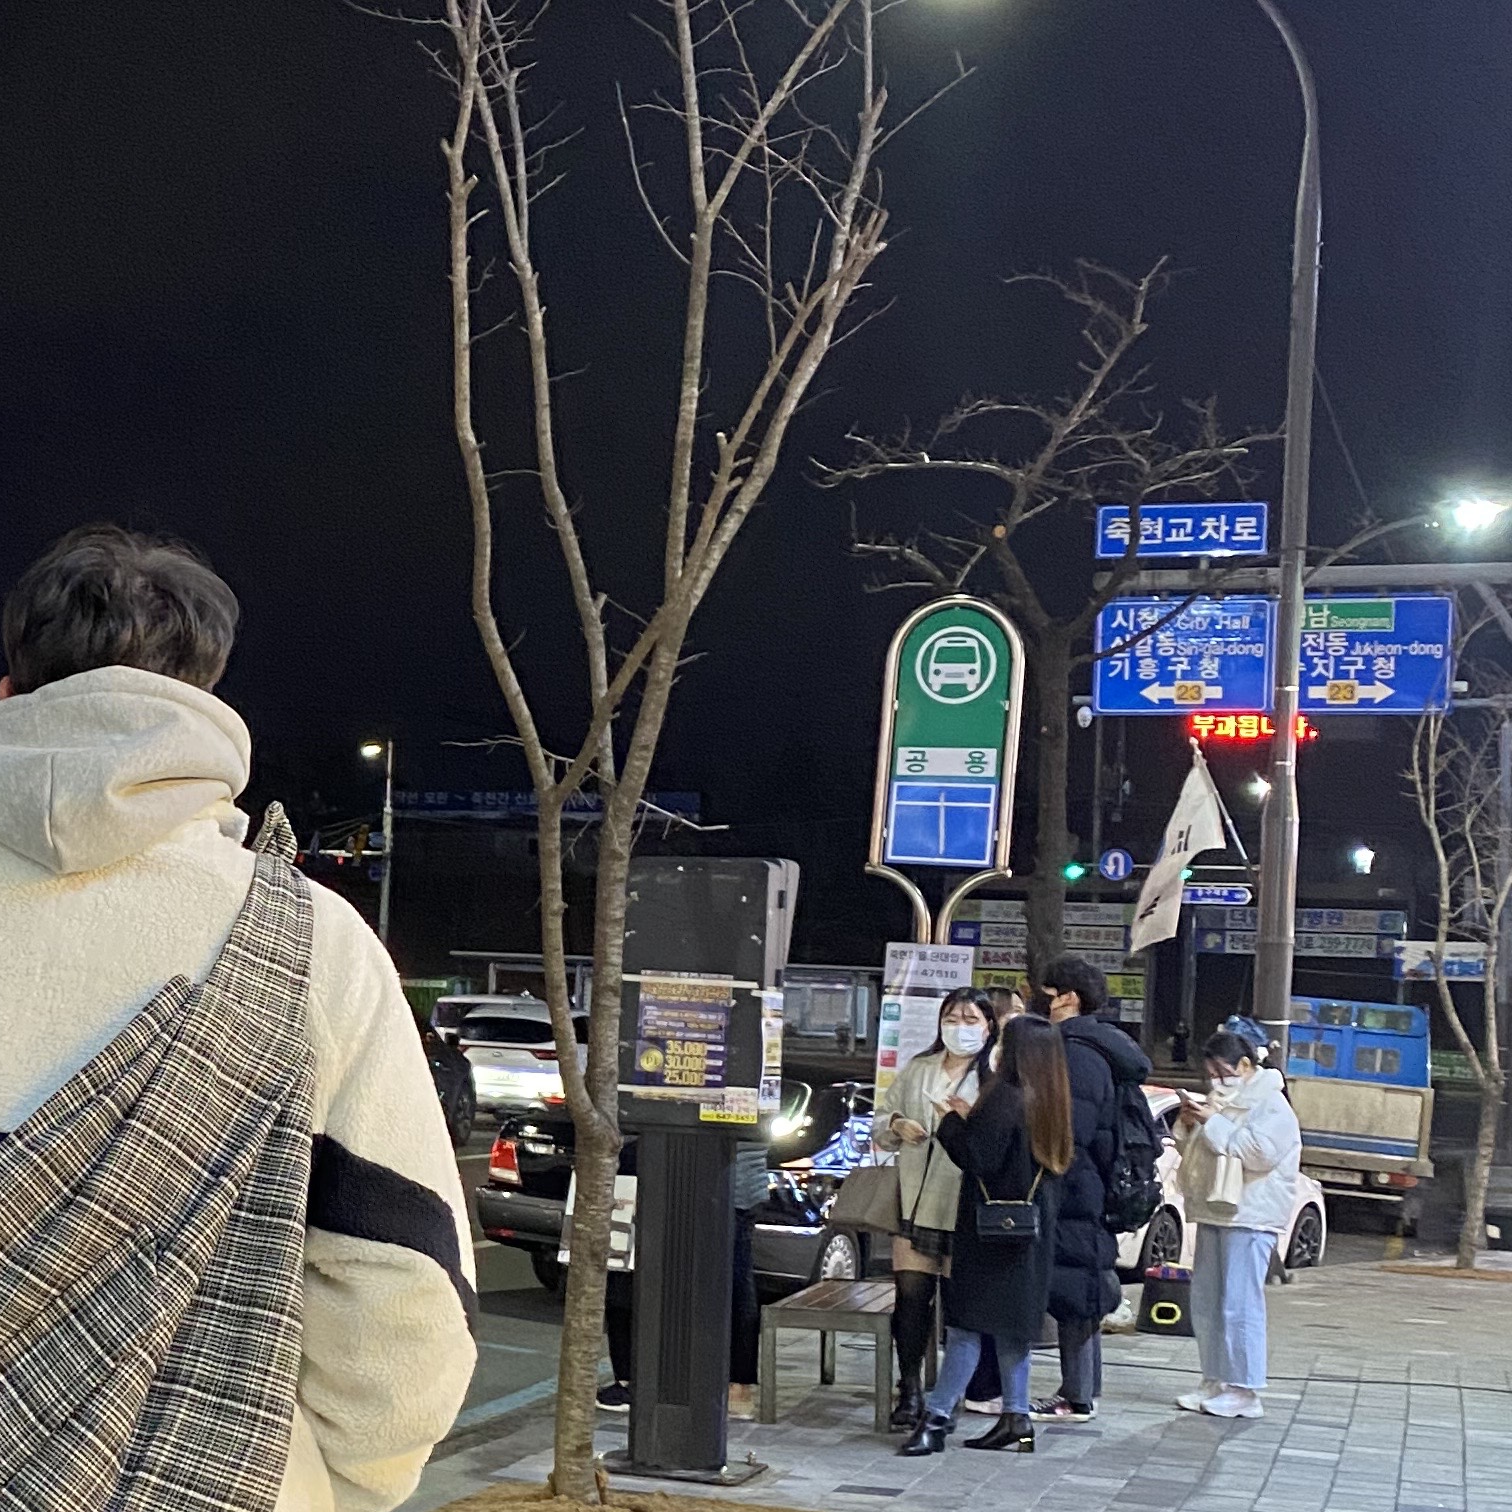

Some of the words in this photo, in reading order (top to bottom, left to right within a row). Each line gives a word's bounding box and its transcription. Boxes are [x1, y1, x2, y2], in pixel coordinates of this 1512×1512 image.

[1104, 515, 1261, 546] 죽현교차로
[1218, 615, 1251, 631] Hall
[1301, 632, 1349, 657] 전동
[1108, 656, 1220, 681] 기흥구청
[1176, 684, 1202, 701] 23
[1327, 683, 1355, 700] 23
